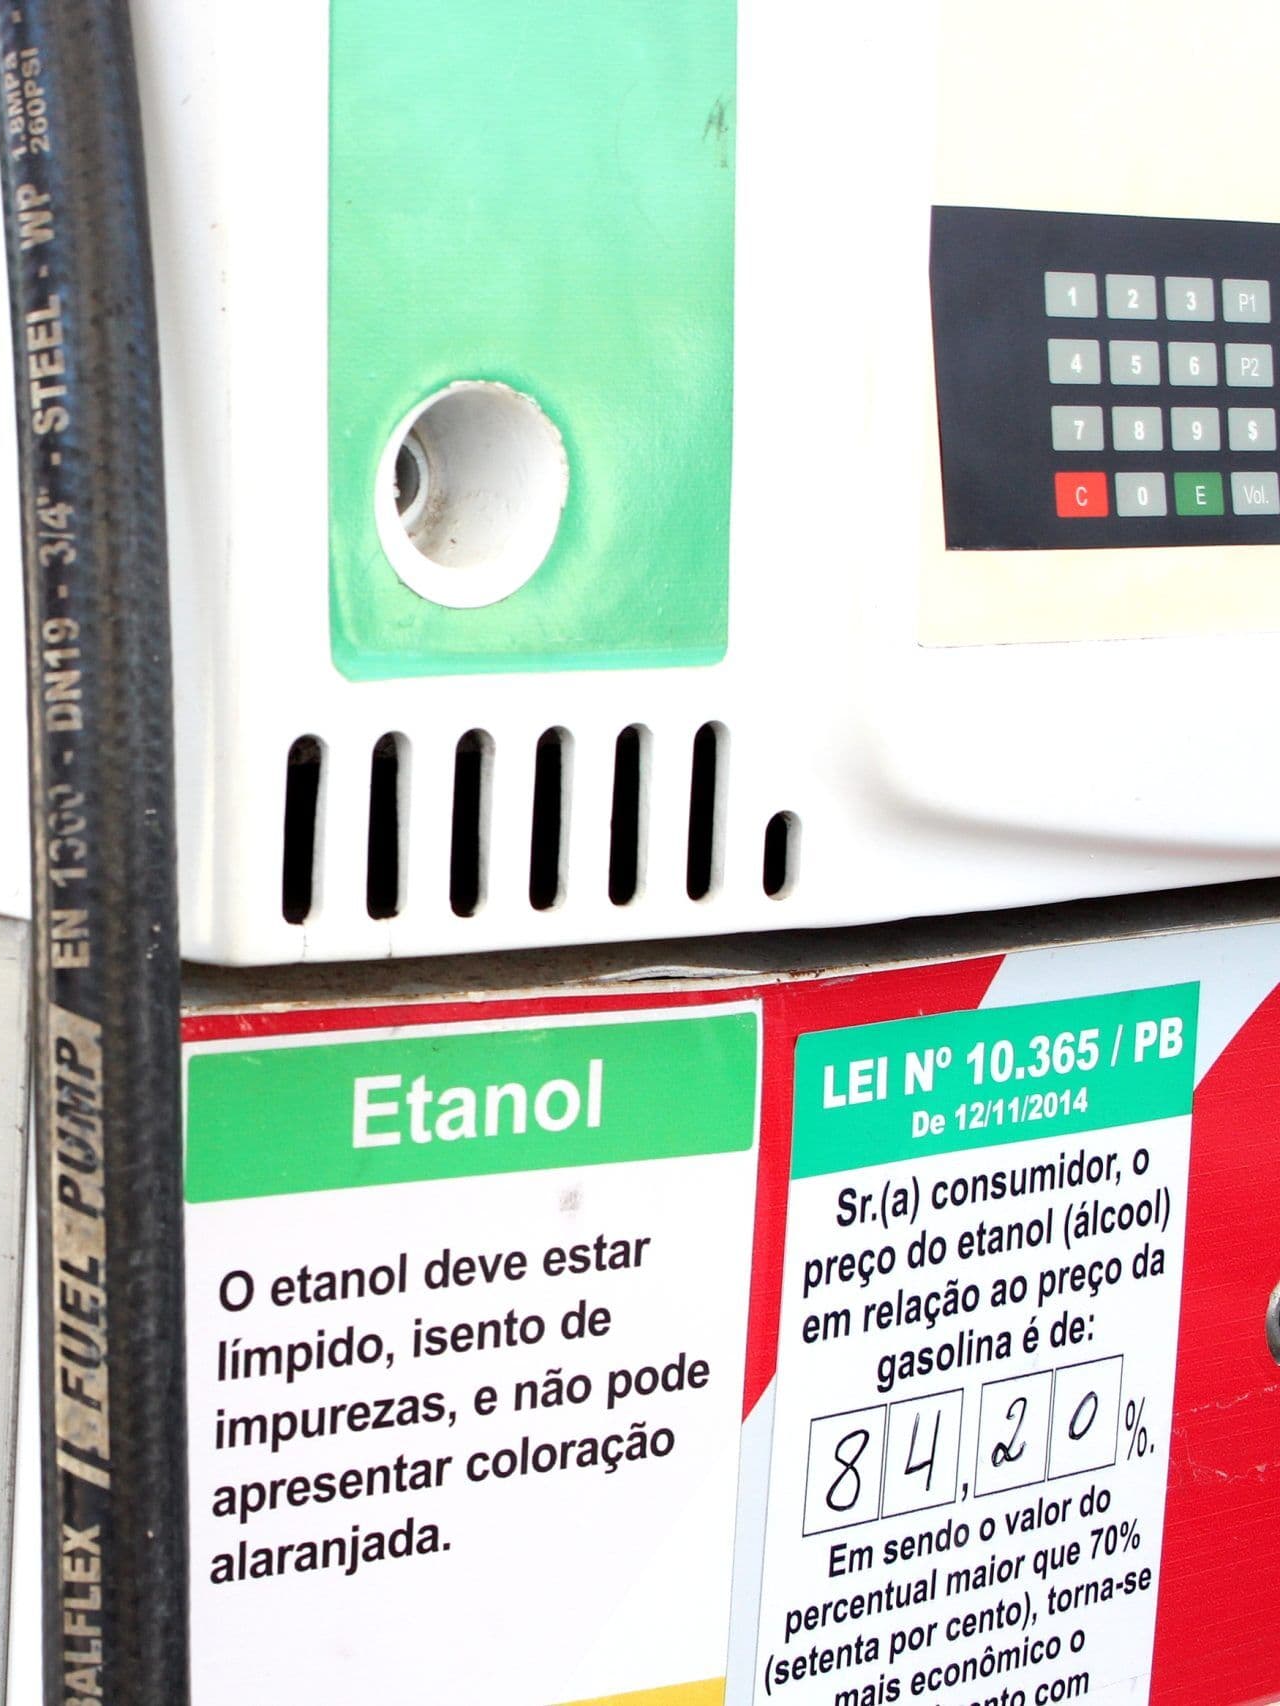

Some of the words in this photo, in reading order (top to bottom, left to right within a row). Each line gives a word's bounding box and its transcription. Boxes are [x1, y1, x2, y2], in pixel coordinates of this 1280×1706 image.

[20, 48, 50, 155] 260PSI
[17, 182, 55, 251] WP
[1067, 286, 1077, 307] 1
[1127, 288, 1139, 309] 2
[1186, 291, 1197, 311] 3
[1238, 293, 1257, 312] P1
[25, 294, 70, 436] STEEL
[1070, 353, 1082, 373] 4
[1131, 355, 1142, 375] 5
[1189, 356, 1200, 375] 6
[1241, 357, 1259, 377] P2
[1074, 420, 1085, 440] 7
[1134, 420, 1145, 440] 8
[1192, 421, 1202, 440] 9
[1076, 486, 1088, 507] C
[1195, 486, 1207, 505] E
[1244, 485, 1269, 504] Vol.
[42, 617, 84, 733] DN19
[50, 909, 90, 969] EN
[352, 1059, 602, 1148] Etanol
[823, 1056, 888, 1109] LEI
[967, 1029, 1100, 1084] 10.365
[1111, 1024, 1124, 1067] /
[1134, 1017, 1184, 1062] PB
[56, 1036, 99, 1219] PUMP
[912, 1110, 945, 1138] De
[954, 1087, 1088, 1131] 12/11/2014
[837, 1176, 920, 1230] Sr.(a)
[932, 1150, 1122, 1210] consumidor,
[1133, 1147, 1149, 1175] o
[219, 1271, 254, 1312] O
[271, 1254, 407, 1307] etanol
[424, 1249, 527, 1291] deve
[542, 1233, 650, 1272] estar
[804, 1245, 896, 1298] preço
[908, 1231, 946, 1269] do
[958, 1208, 1053, 1258] etanol
[1063, 1186, 1171, 1250] (álcool)
[60, 1256, 104, 1413] FUEL
[803, 1307, 850, 1344] em
[862, 1279, 980, 1331] relação
[991, 1276, 1027, 1308] ao
[1038, 1256, 1121, 1307] preço
[1132, 1243, 1165, 1279] da
[218, 1326, 395, 1383] límpido,
[413, 1308, 545, 1357] isento
[560, 1299, 611, 1340] de
[877, 1327, 1011, 1392] gasolina
[1024, 1316, 1039, 1353] é
[1050, 1311, 1094, 1347] de:
[216, 1387, 457, 1454] impurezas,
[474, 1384, 497, 1415] e
[514, 1369, 591, 1413] não
[607, 1353, 709, 1409] pode
[213, 1452, 451, 1523] apresentar
[466, 1421, 675, 1482] coloração
[210, 1518, 451, 1585] alaranjada.
[828, 1543, 873, 1578] Em
[884, 1519, 969, 1564] sendo
[980, 1518, 995, 1542] o
[1005, 1497, 1072, 1535] valor
[1079, 1485, 1111, 1515] do
[785, 1569, 936, 1643] percentual
[947, 1555, 1025, 1596] maior
[1033, 1539, 1080, 1580] que
[1090, 1518, 1141, 1559] 70%
[764, 1634, 879, 1696] (setenta
[890, 1622, 937, 1663] por
[946, 1591, 1037, 1641] cento),
[1048, 1567, 1152, 1616] torna-se
[835, 1674, 901, 1706] mais
[910, 1636, 1061, 1694] econômico
[1070, 1629, 1085, 1652] o
[1036, 1672, 1089, 1706] com
